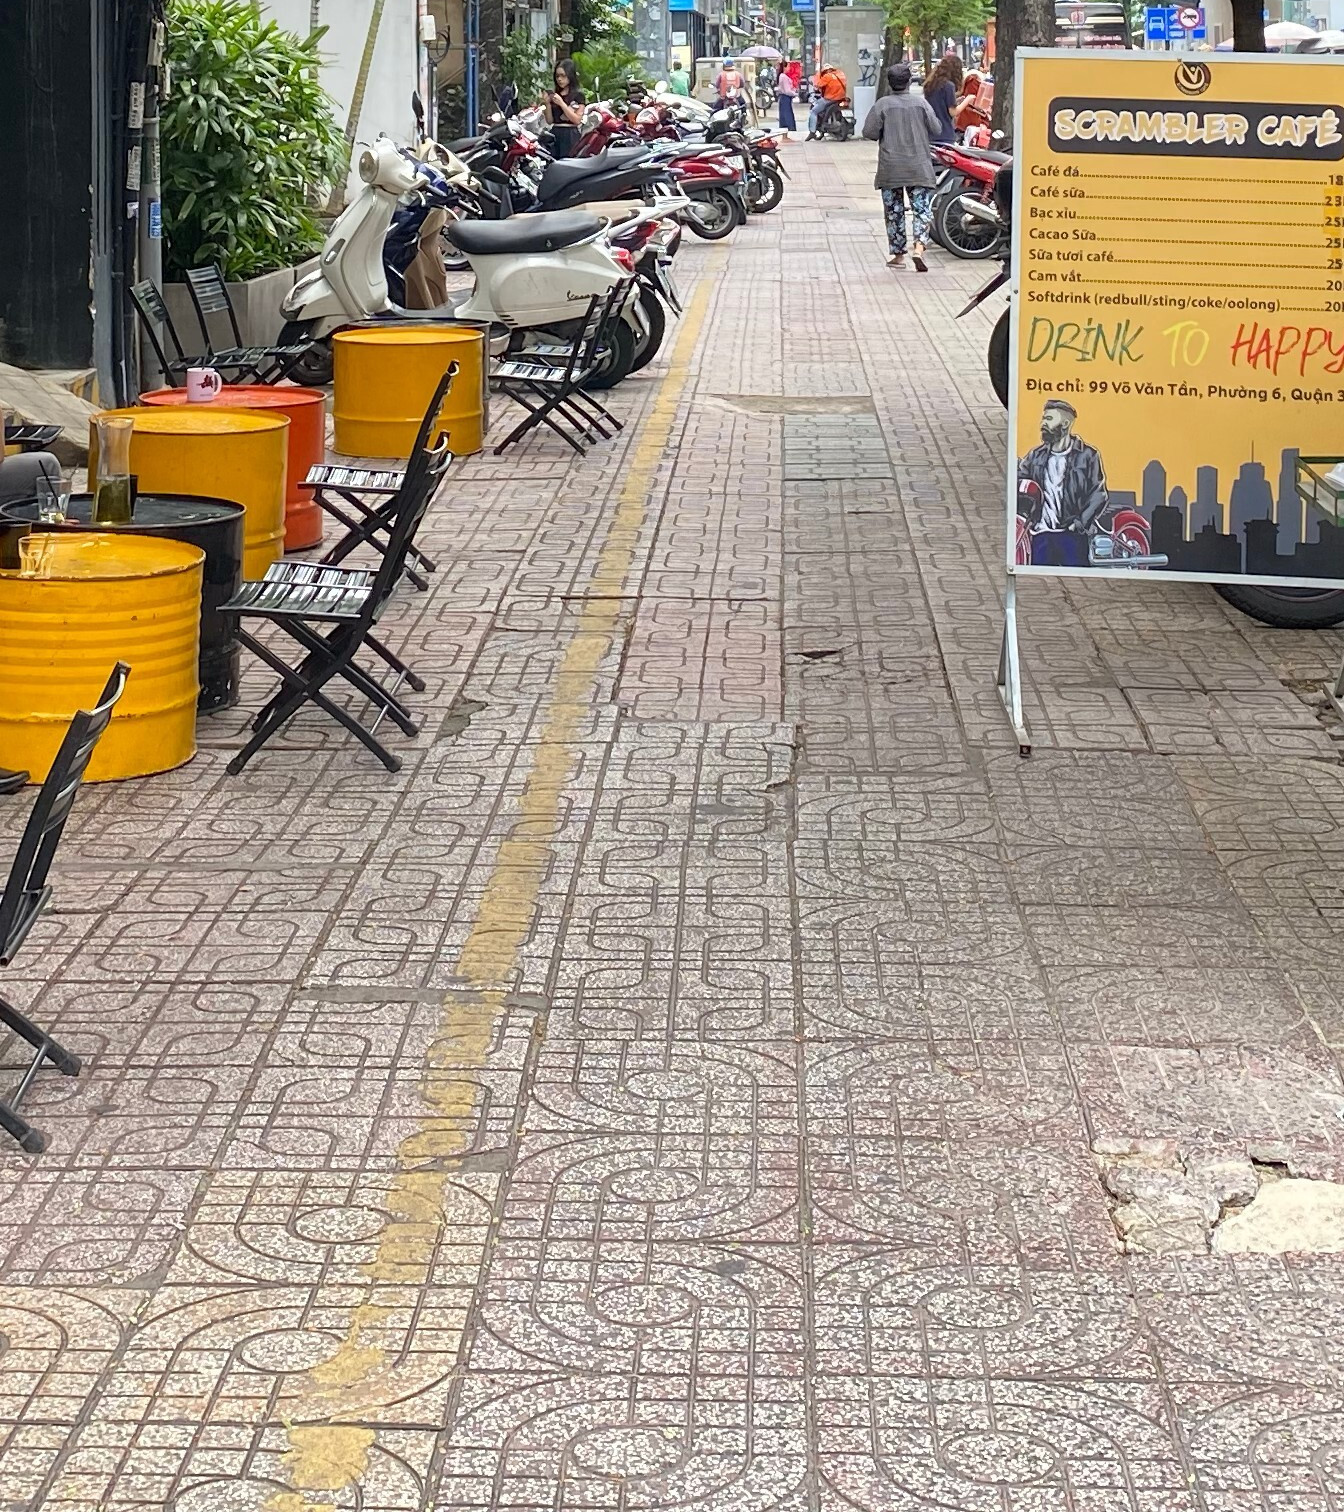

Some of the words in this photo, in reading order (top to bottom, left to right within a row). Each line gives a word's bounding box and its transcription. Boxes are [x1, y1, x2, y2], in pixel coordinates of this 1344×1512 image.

[1054, 108, 1249, 145] SCRAMBLER
[1257, 109, 1343, 148] CAFÉ
[1030, 164, 1060, 177] Café
[1030, 186, 1060, 198] Café
[1029, 207, 1054, 221] Bạc
[1029, 227, 1069, 240] Cacao
[1028, 248, 1053, 260] Sữa
[1056, 250, 1083, 262] tươi
[1028, 270, 1057, 282] Cam
[1027, 290, 1091, 305] Softdrink
[1026, 317, 1144, 367] DRINK
[1161, 320, 1210, 368] TO
[1025, 378, 1053, 393] Địa
[1056, 377, 1085, 394] chỉ:
[1088, 380, 1108, 394] 99
[1111, 380, 1131, 395] Võ
[1134, 380, 1164, 396] Văn
[1167, 379, 1204, 399] Tần,
[1207, 384, 1268, 402] Phường
[1271, 386, 1287, 402] 6,
[1290, 388, 1333, 404] Quận
